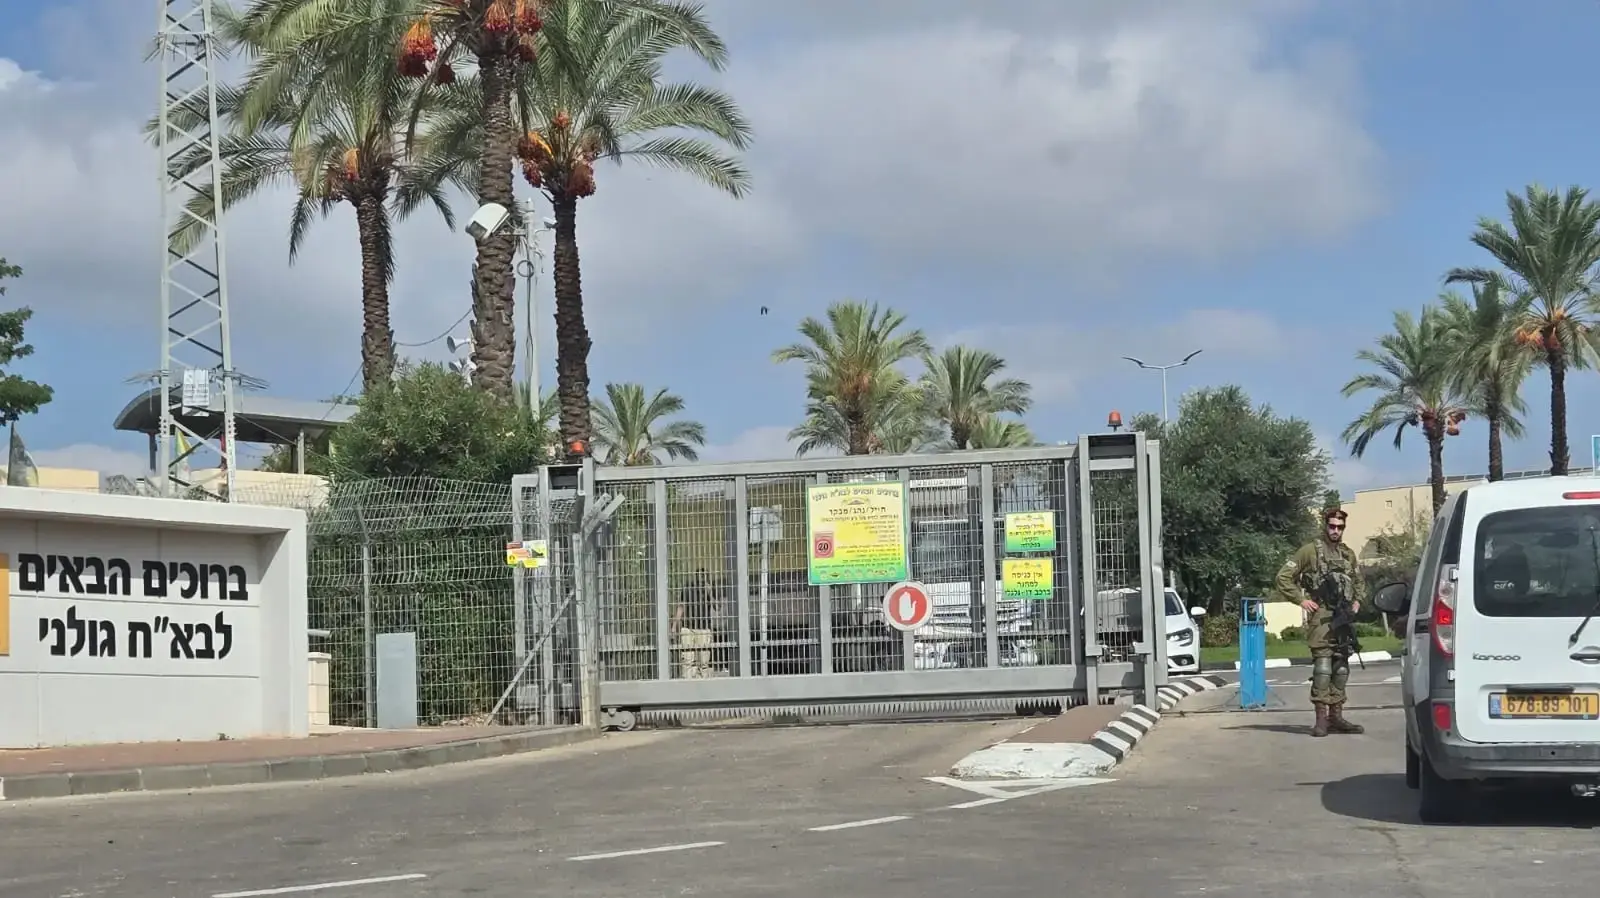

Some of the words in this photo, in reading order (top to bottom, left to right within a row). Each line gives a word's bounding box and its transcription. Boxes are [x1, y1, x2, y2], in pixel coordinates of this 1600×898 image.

[818, 542, 829, 552] 20
[18, 552, 131, 596] הבאים
[142, 559, 249, 601] ברוכים
[39, 604, 116, 657] גולני
[128, 610, 233, 660] לבא"ח
